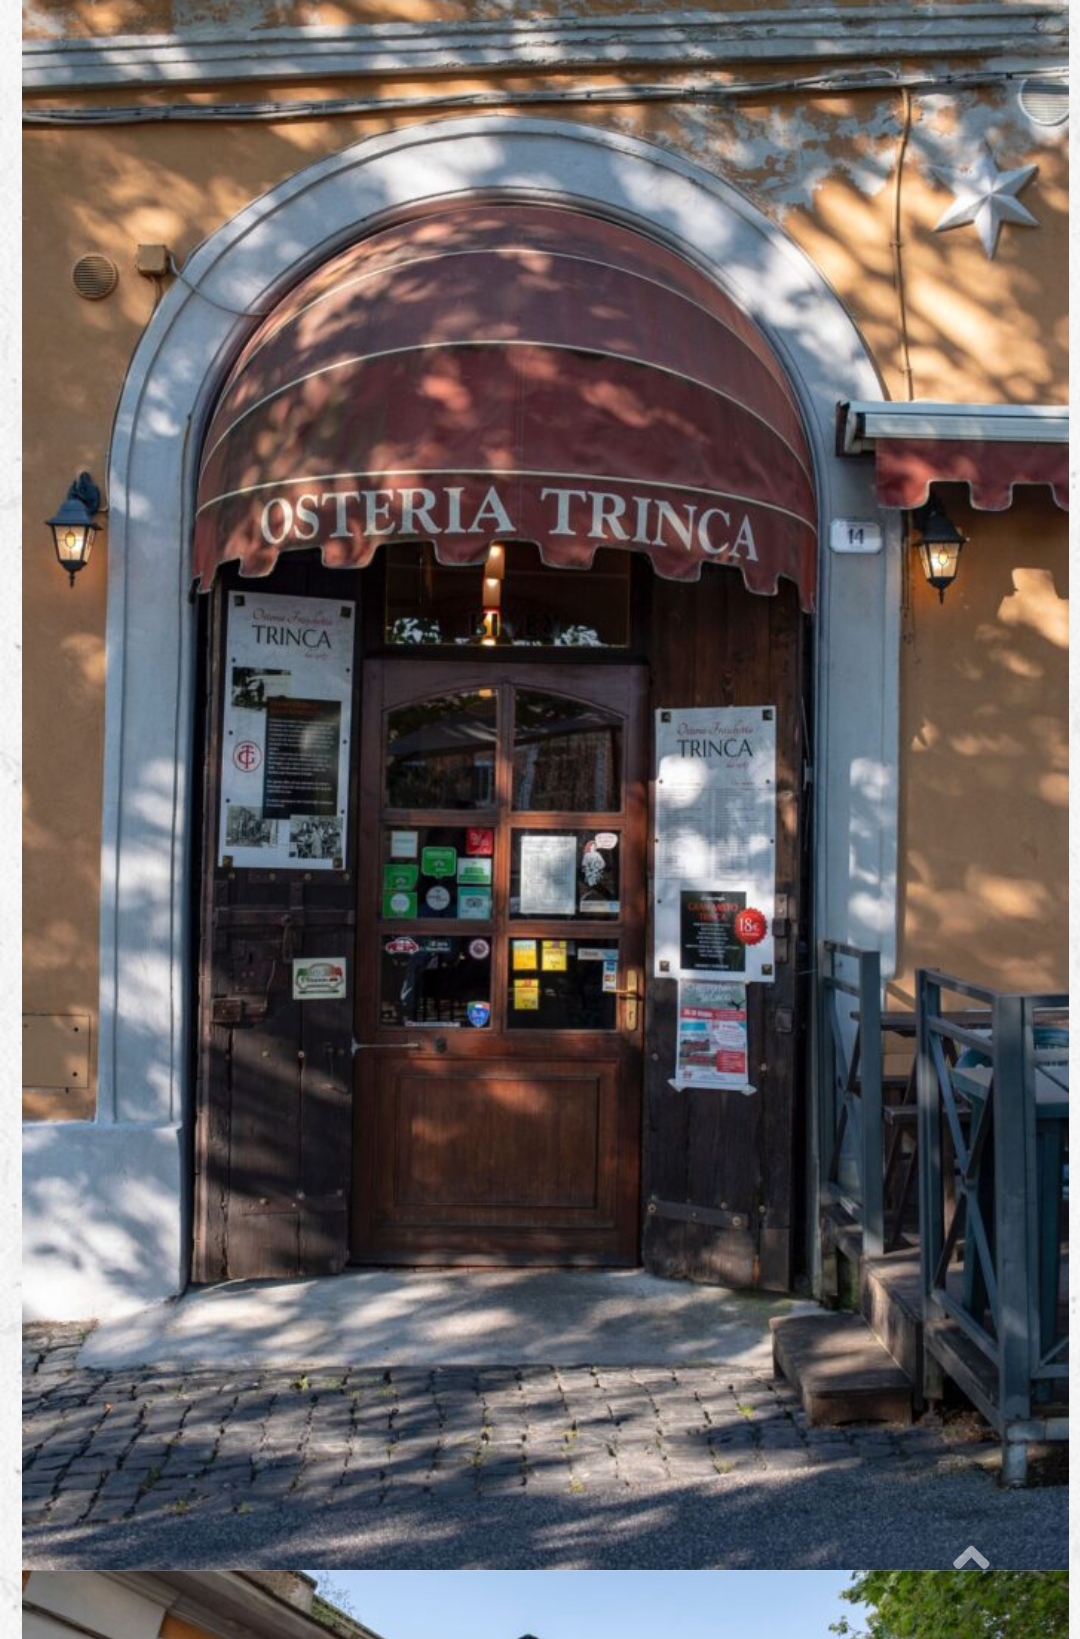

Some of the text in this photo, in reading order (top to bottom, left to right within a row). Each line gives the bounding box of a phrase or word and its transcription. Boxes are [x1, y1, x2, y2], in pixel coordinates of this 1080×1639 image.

[260, 485, 760, 562] OSTERIA TRINCA
[848, 528, 864, 544] 14
[252, 624, 332, 649] TRINCA
[677, 739, 753, 758] TRINCA
